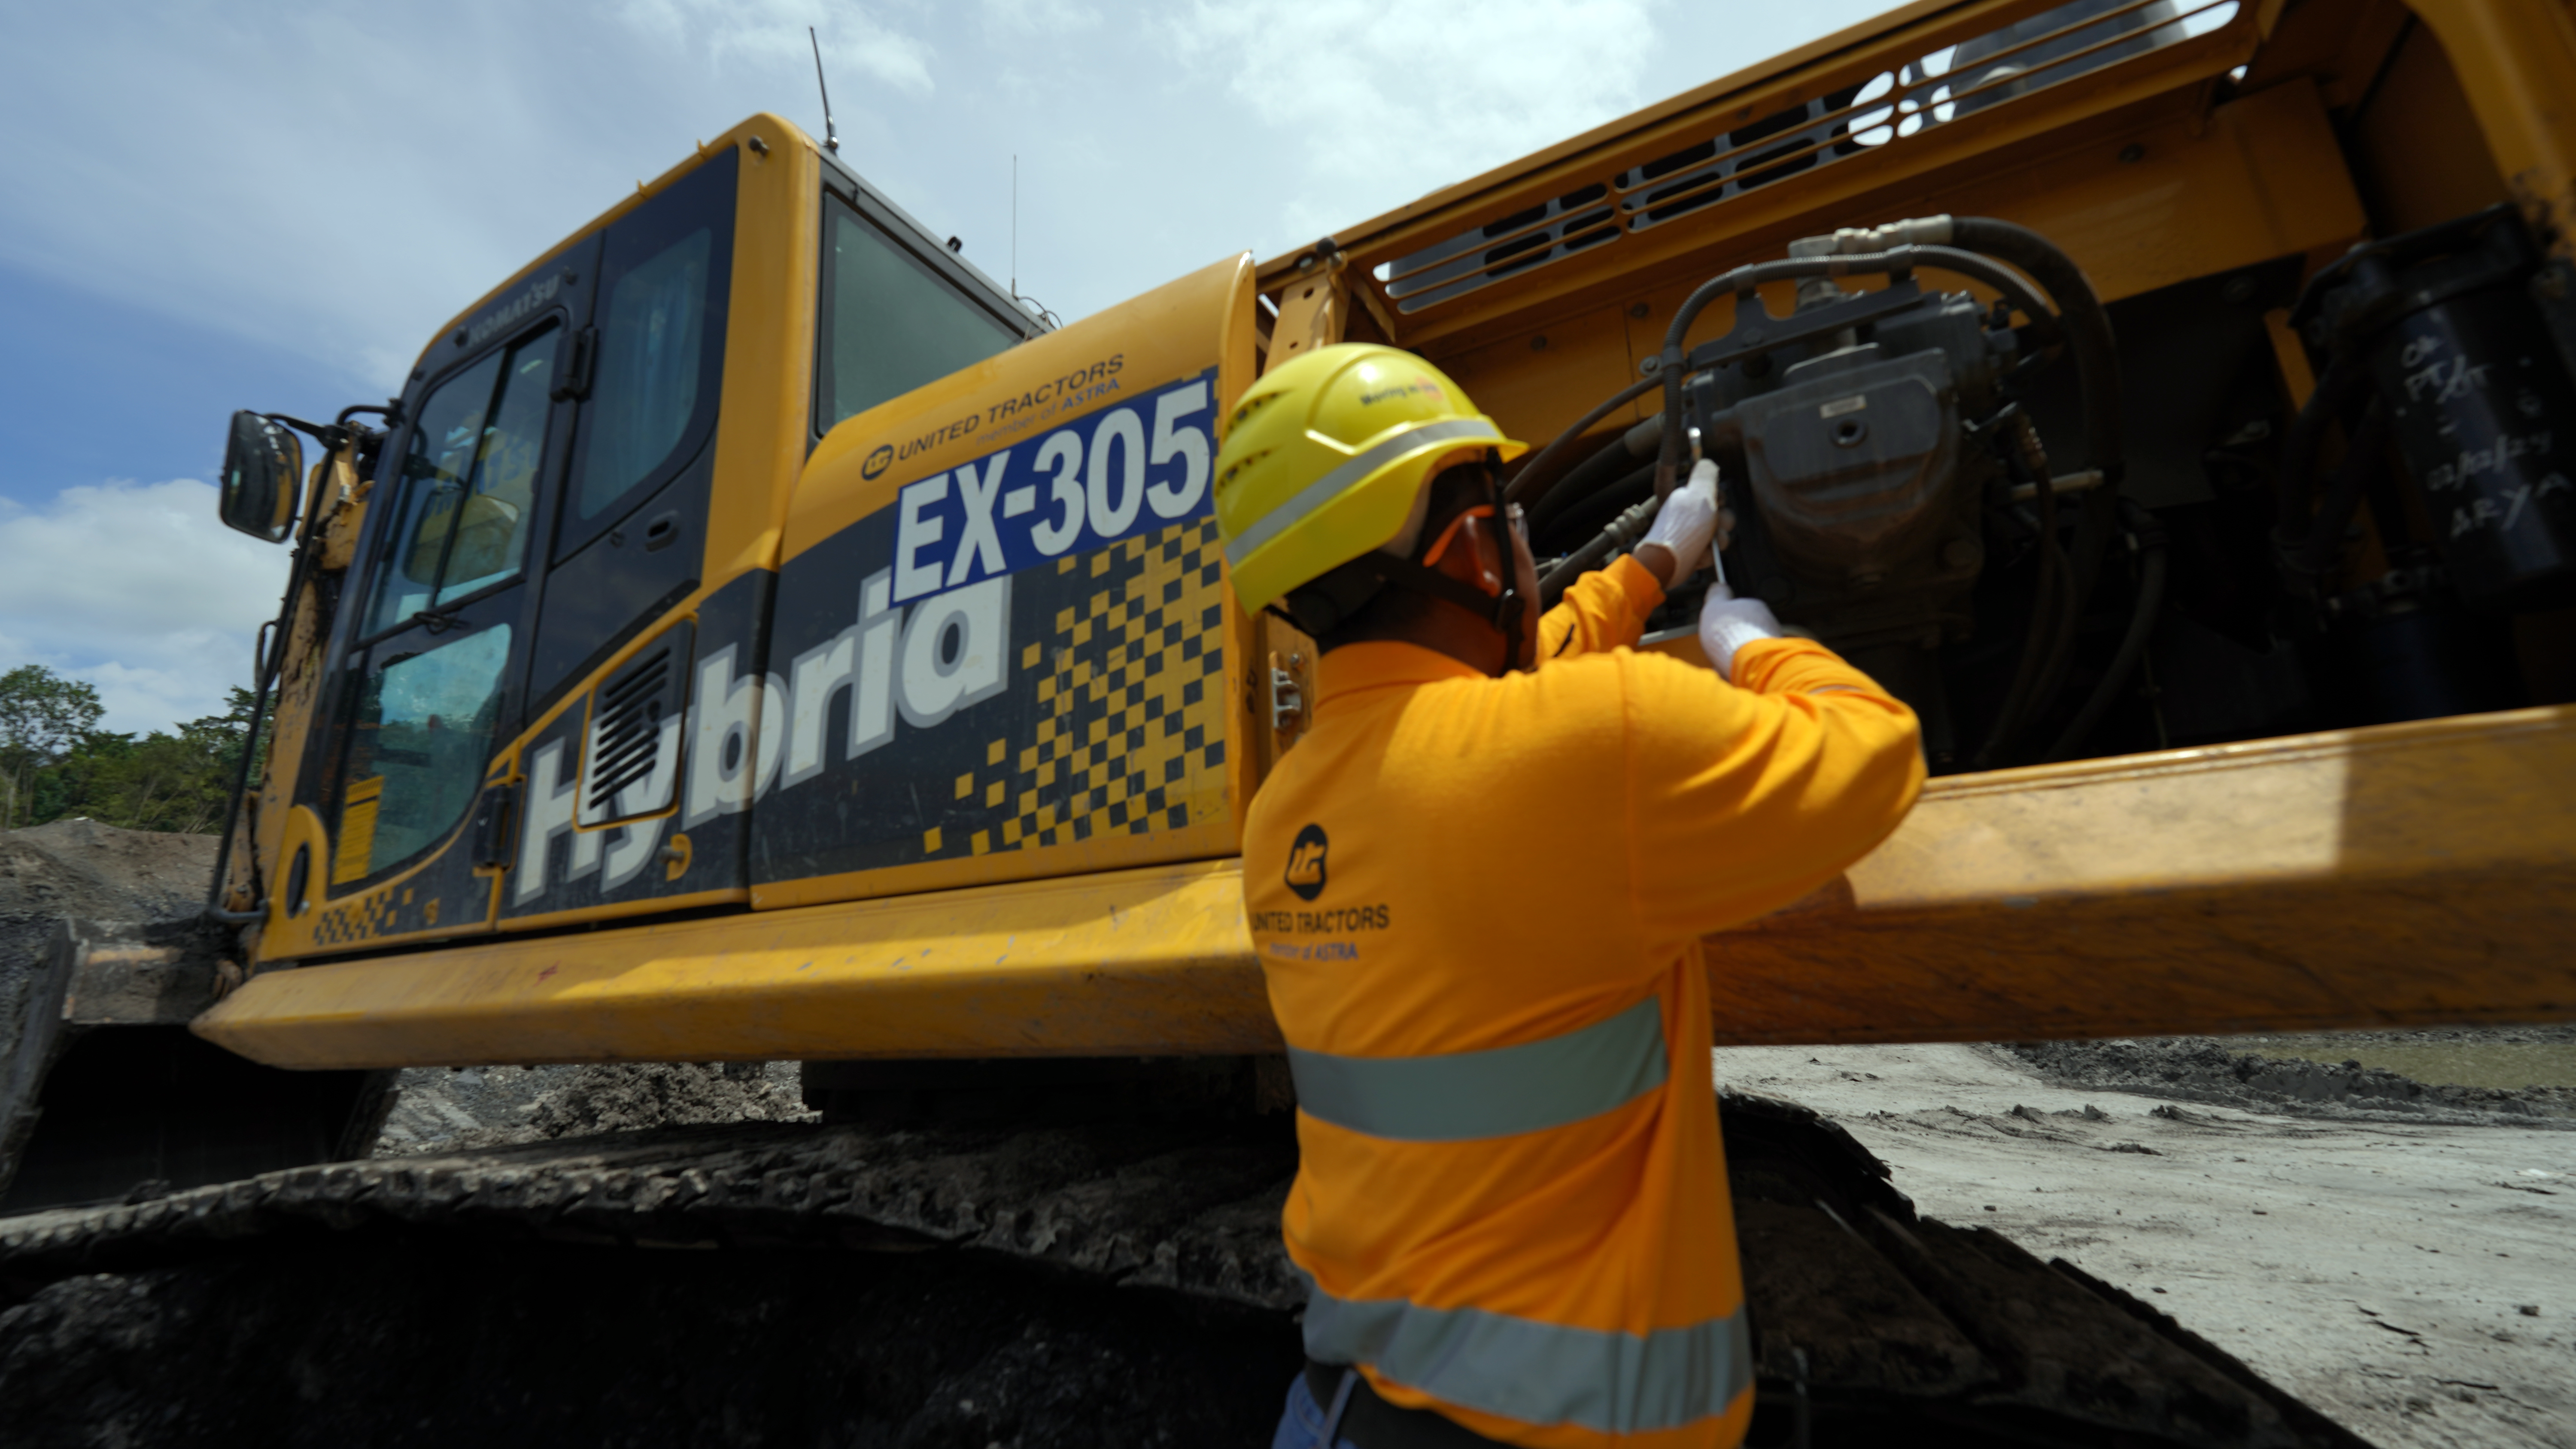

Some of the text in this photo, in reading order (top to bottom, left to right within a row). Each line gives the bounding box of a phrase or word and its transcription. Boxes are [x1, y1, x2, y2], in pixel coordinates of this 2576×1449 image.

[899, 354, 1124, 461] UNITED TRACTORS
[976, 378, 1120, 447] member of ASTRA
[893, 379, 1210, 603] EX-305
[1297, 904, 1390, 933] TRACTORS
[1315, 941, 1359, 961] ASTRA
